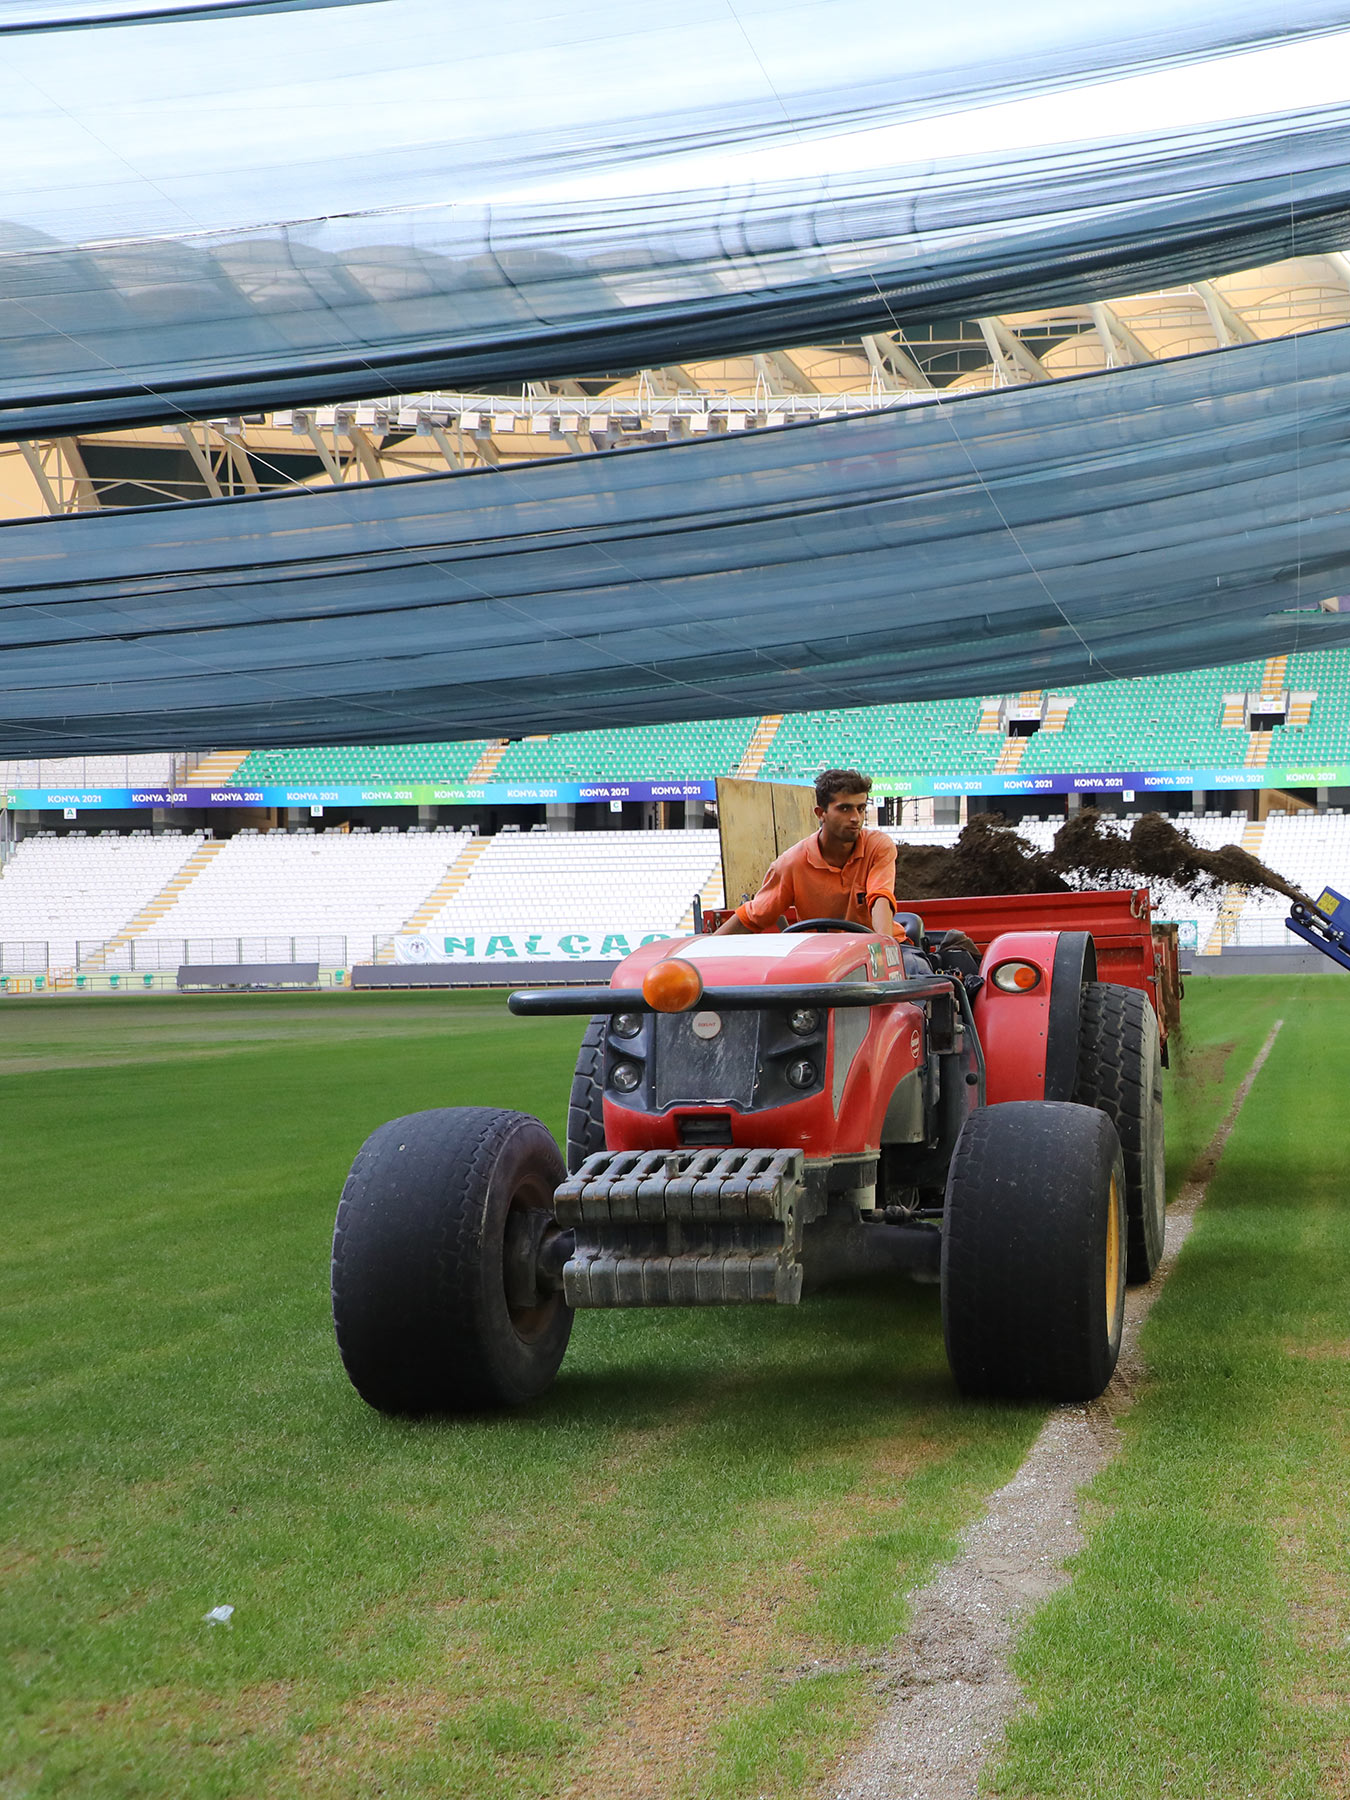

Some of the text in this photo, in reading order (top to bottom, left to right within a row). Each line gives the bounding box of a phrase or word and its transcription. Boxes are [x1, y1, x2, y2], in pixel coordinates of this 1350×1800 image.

[1144, 776, 1193, 786] KONYA 2021
[1215, 775, 1264, 784] KONYA 2021
[1286, 772, 1336, 782] KONYA 2021
[870, 782, 912, 791] ONYA 2021
[933, 781, 982, 791] KONYA 2021
[1004, 780, 1052, 789] KONYA 2021
[1074, 779, 1123, 788] KONYA 2021
[434, 790, 485, 799] KONYA 2021
[507, 789, 557, 798] KONYA 2021
[579, 788, 629, 797] KONYA 2021
[651, 786, 701, 795] KONYA 2021
[48, 795, 102, 803] KONYA 2021
[132, 794, 164, 802] KONYA
[211, 793, 264, 802] KONYA 2021
[287, 792, 339, 801] KONYA 2021
[361, 791, 413, 800] KONYA 2021
[444, 933, 693, 958] NALÇA
